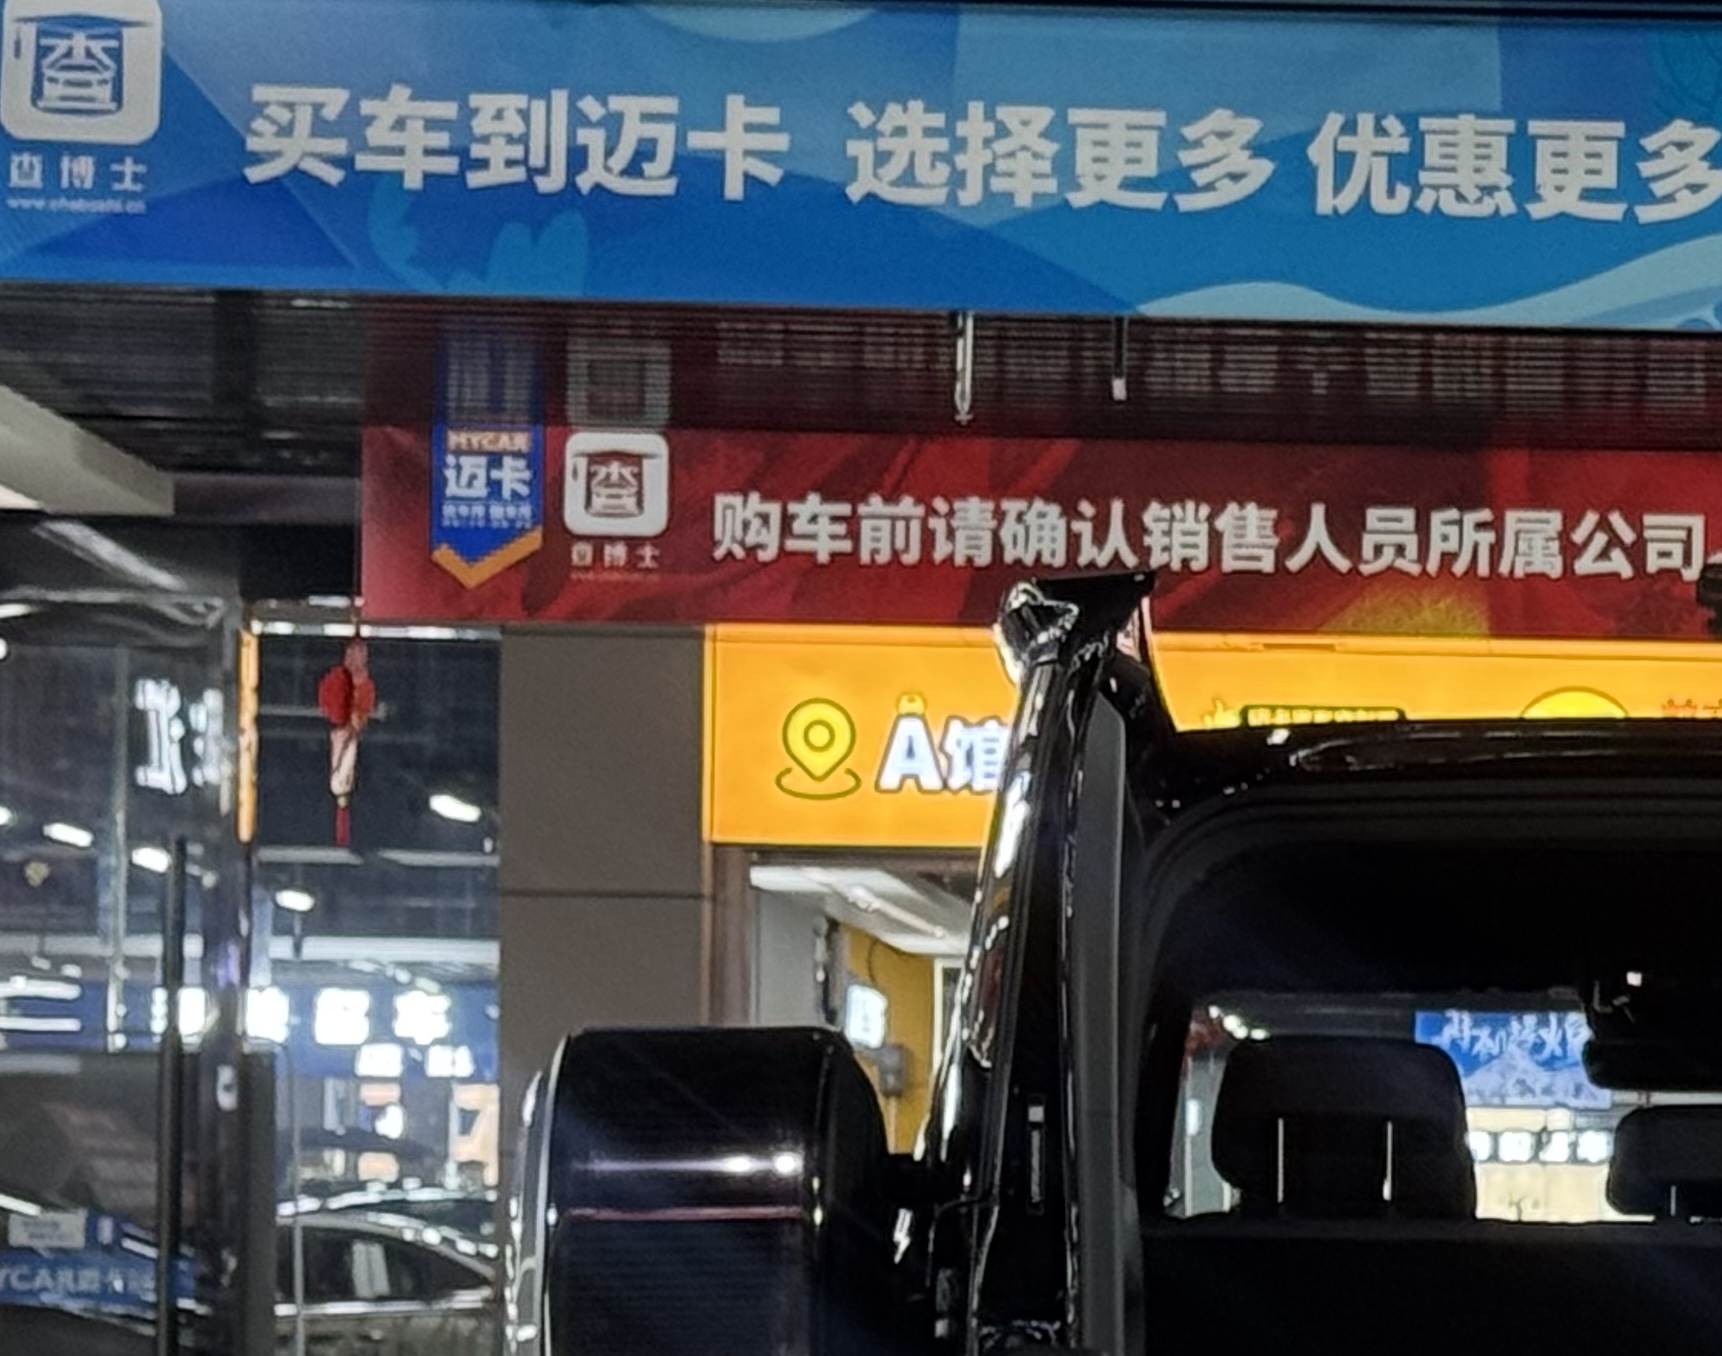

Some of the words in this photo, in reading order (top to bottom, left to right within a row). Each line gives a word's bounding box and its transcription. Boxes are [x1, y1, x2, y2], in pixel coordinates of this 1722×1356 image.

[244, 84, 790, 201] 买车到迈卡
[845, 98, 1277, 213] 选择更多
[443, 454, 533, 501] 迈卡
[713, 490, 1706, 583] 购车前请确认销售人员所属公司
